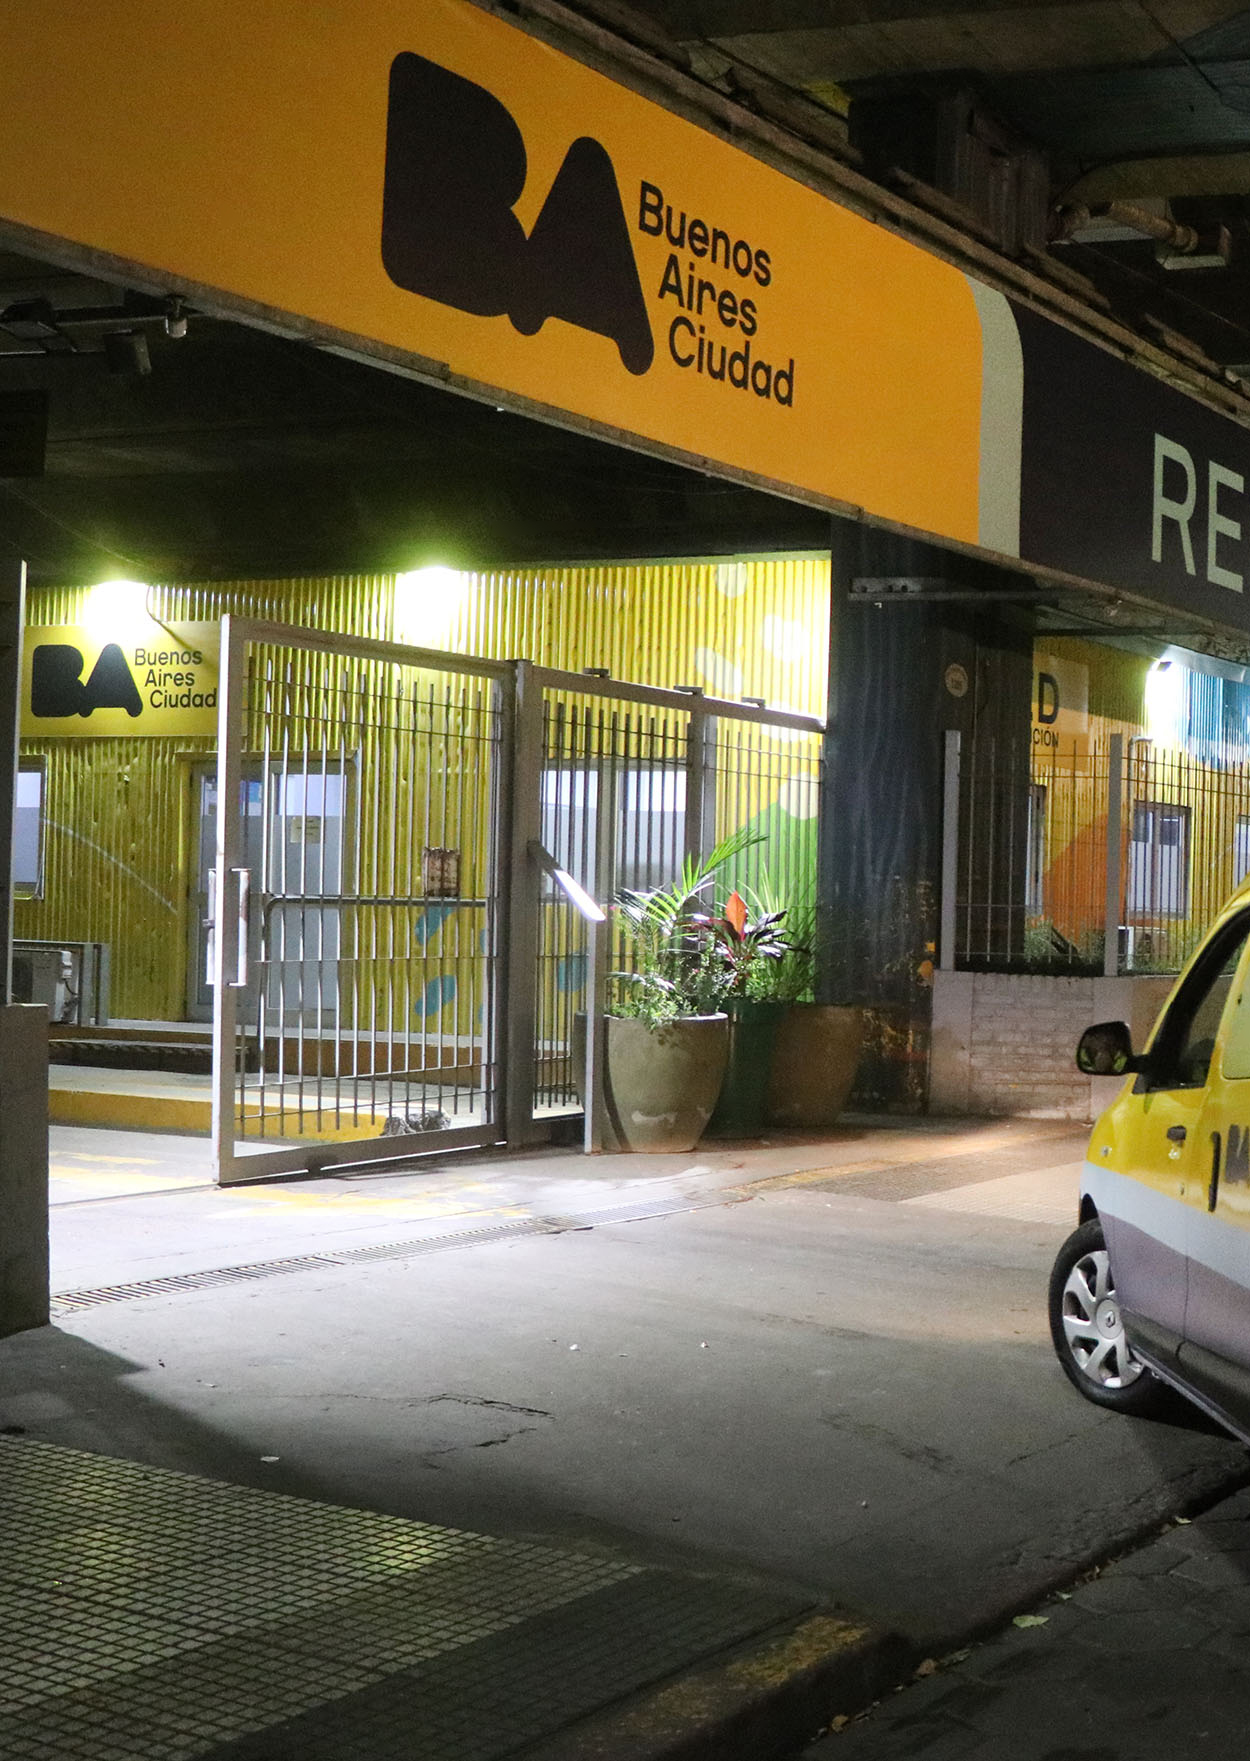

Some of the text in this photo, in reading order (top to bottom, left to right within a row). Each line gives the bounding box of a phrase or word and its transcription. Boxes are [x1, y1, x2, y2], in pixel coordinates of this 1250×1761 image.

[381, 51, 654, 376] BA
[638, 180, 771, 287] Buenos
[657, 254, 758, 337] Aires
[669, 316, 795, 408] Ciudad
[31, 643, 143, 718] BA
[134, 648, 203, 666] Buenos
[144, 669, 195, 687] Aires
[149, 688, 217, 708] Ciudad
[1032, 727, 1059, 748] CIÓN
